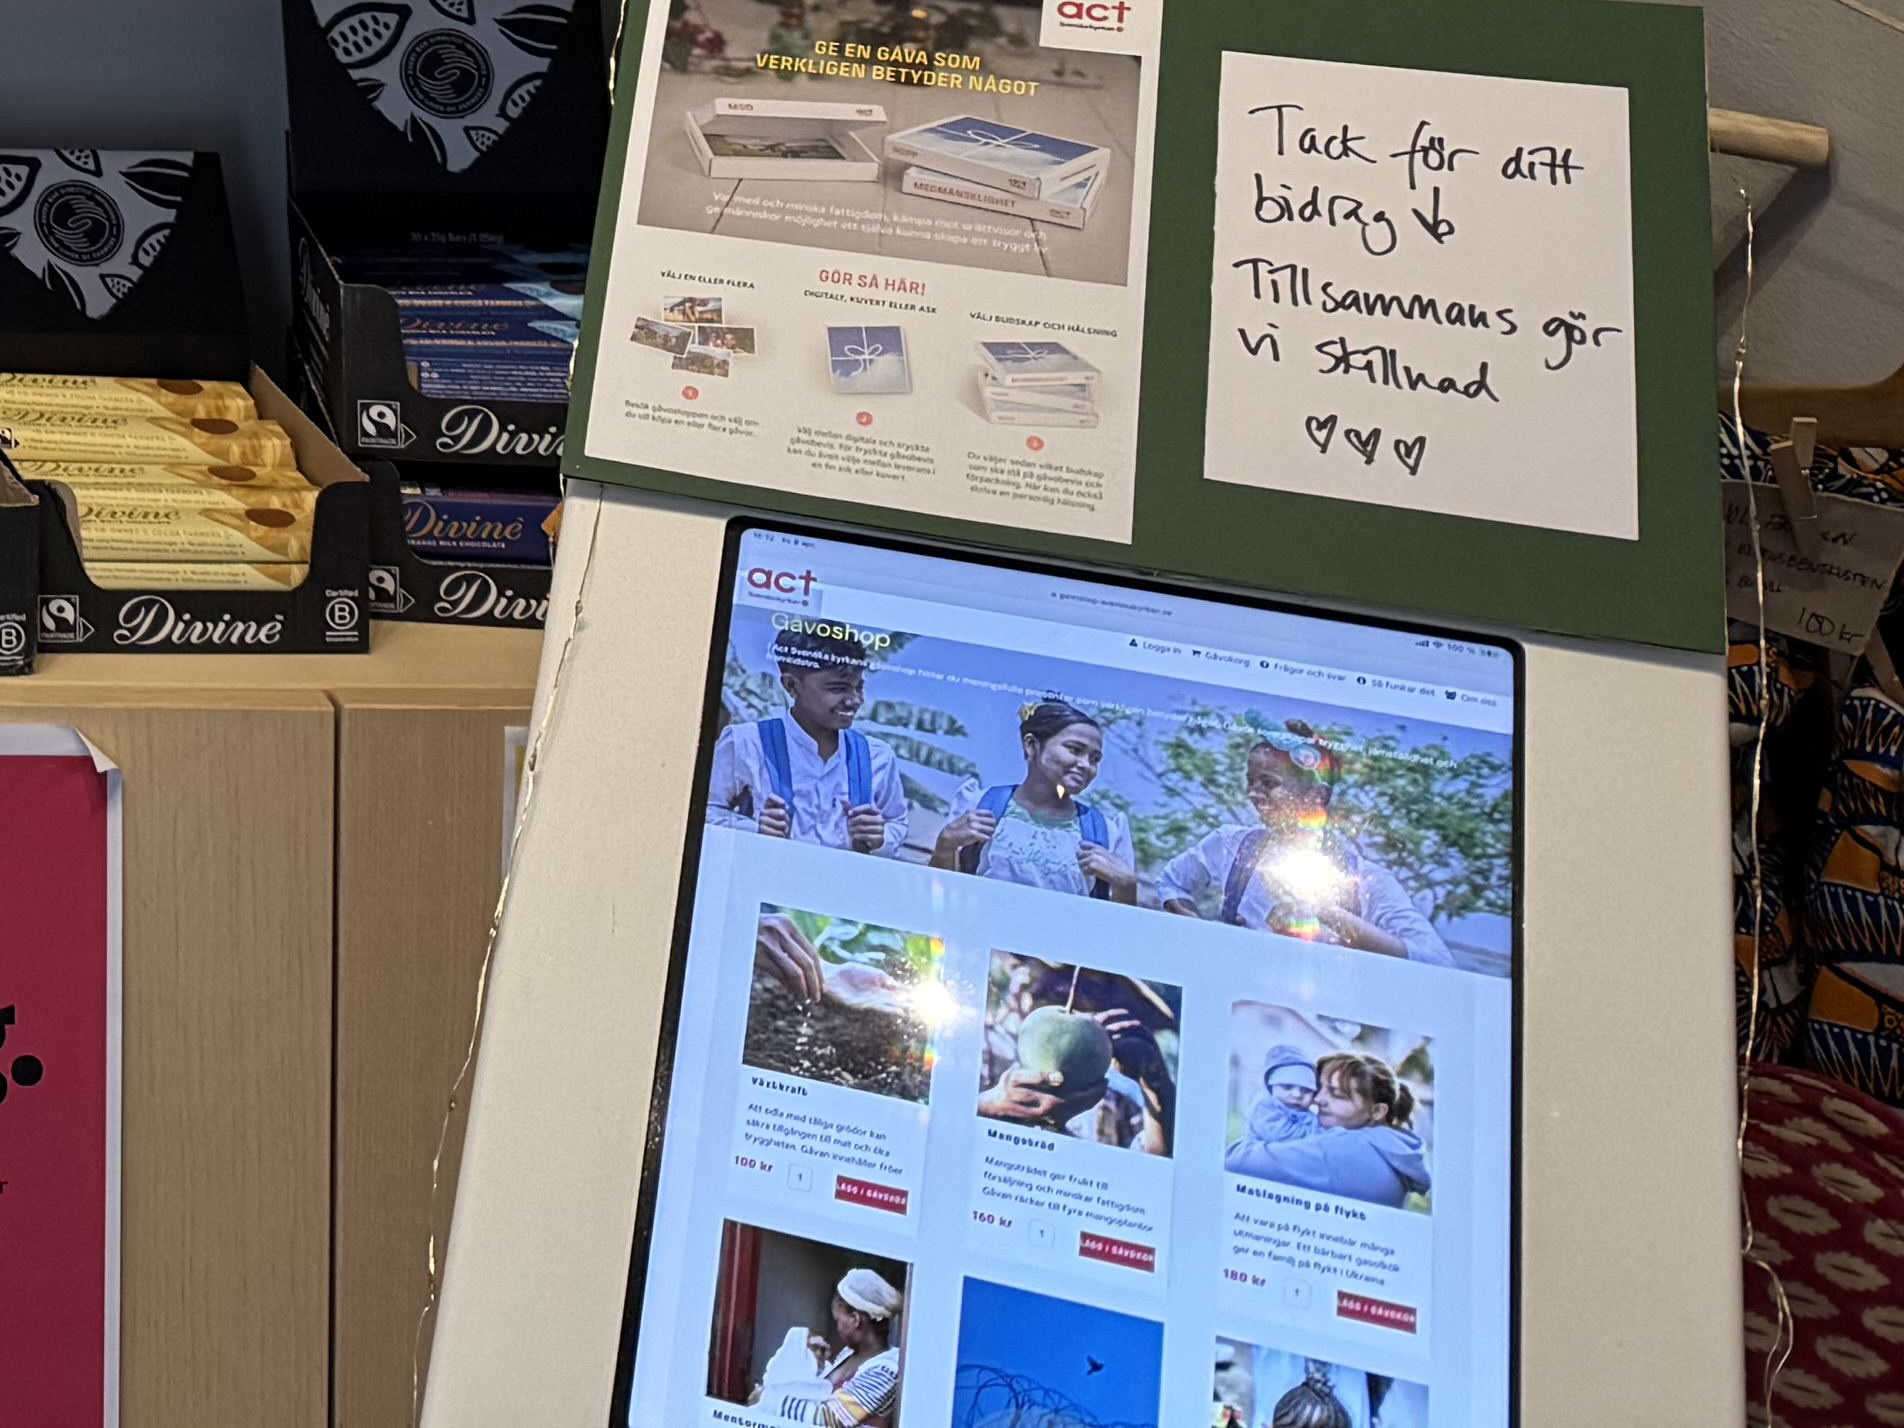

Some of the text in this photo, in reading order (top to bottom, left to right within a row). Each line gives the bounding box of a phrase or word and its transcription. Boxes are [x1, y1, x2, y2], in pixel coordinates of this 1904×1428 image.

[755, 52, 1040, 98] VERKLIGEN BETYDER NÅGOT
[814, 40, 982, 71] GE EN GÅVA SOM
[1247, 103, 1585, 191] Tack för ditt
[1254, 173, 1398, 256] bidrag
[818, 268, 927, 298] GÖR SÅ HÄR!
[1231, 257, 1623, 371] Tillsammans gör
[1237, 322, 1500, 402] vi skillnad
[745, 563, 820, 599] act
[770, 608, 894, 651] Gåvoshop
